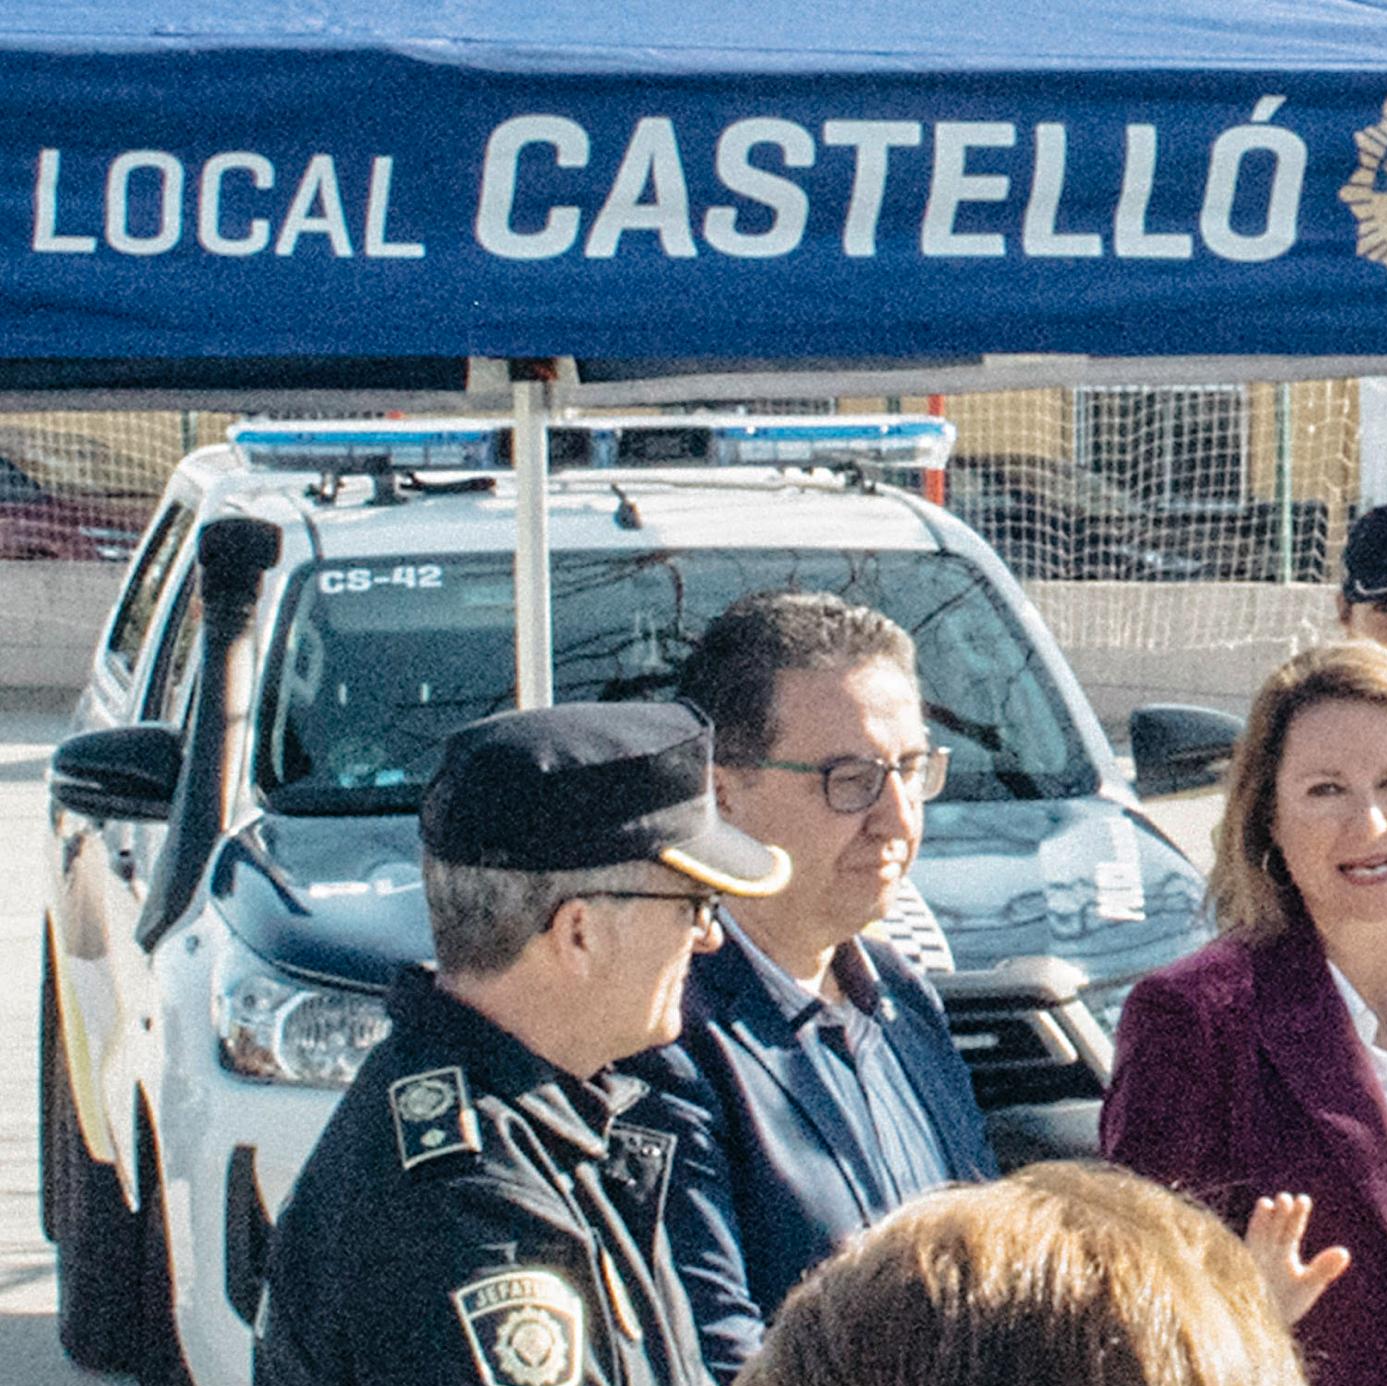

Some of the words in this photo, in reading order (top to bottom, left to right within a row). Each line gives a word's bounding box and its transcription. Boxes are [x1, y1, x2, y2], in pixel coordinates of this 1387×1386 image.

[33, 148, 426, 258] LOCAL
[475, 95, 1308, 262] CASTELLÓ
[319, 564, 442, 594] CS-42
